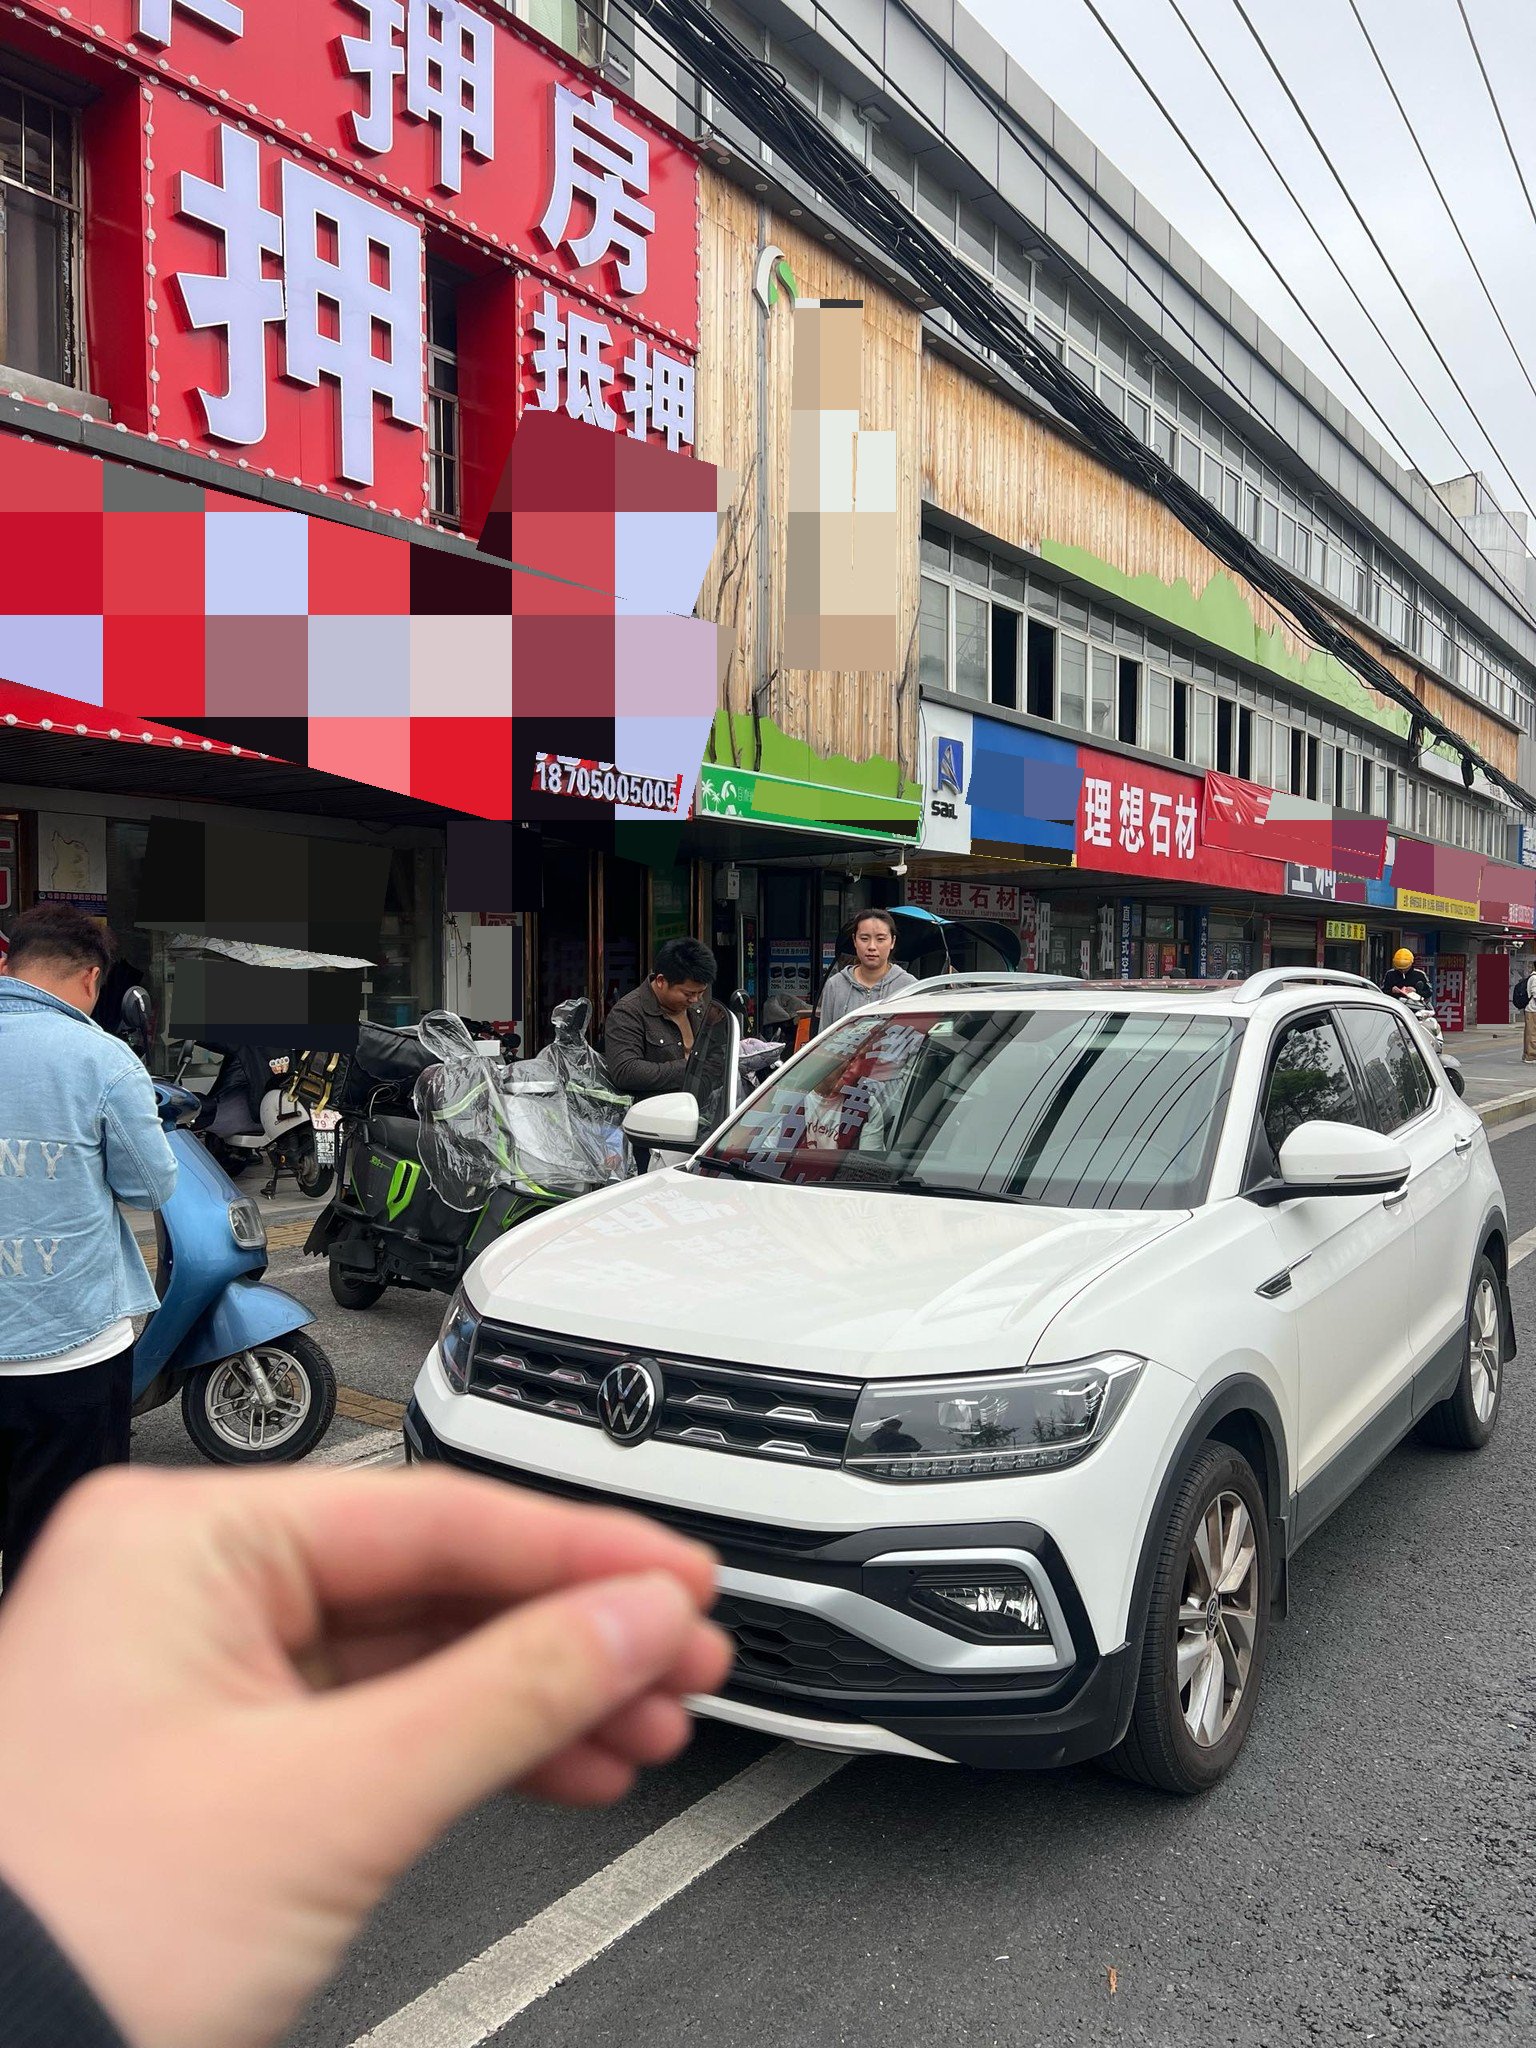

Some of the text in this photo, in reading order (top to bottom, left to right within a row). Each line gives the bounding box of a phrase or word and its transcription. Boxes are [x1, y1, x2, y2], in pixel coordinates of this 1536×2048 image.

[176, 123, 424, 487] 押
[533, 290, 695, 454] 抵押
[536, 761, 678, 810] 18705005005
[1084, 777, 1198, 860] 理想石材
[907, 880, 1018, 911] 理想石材
